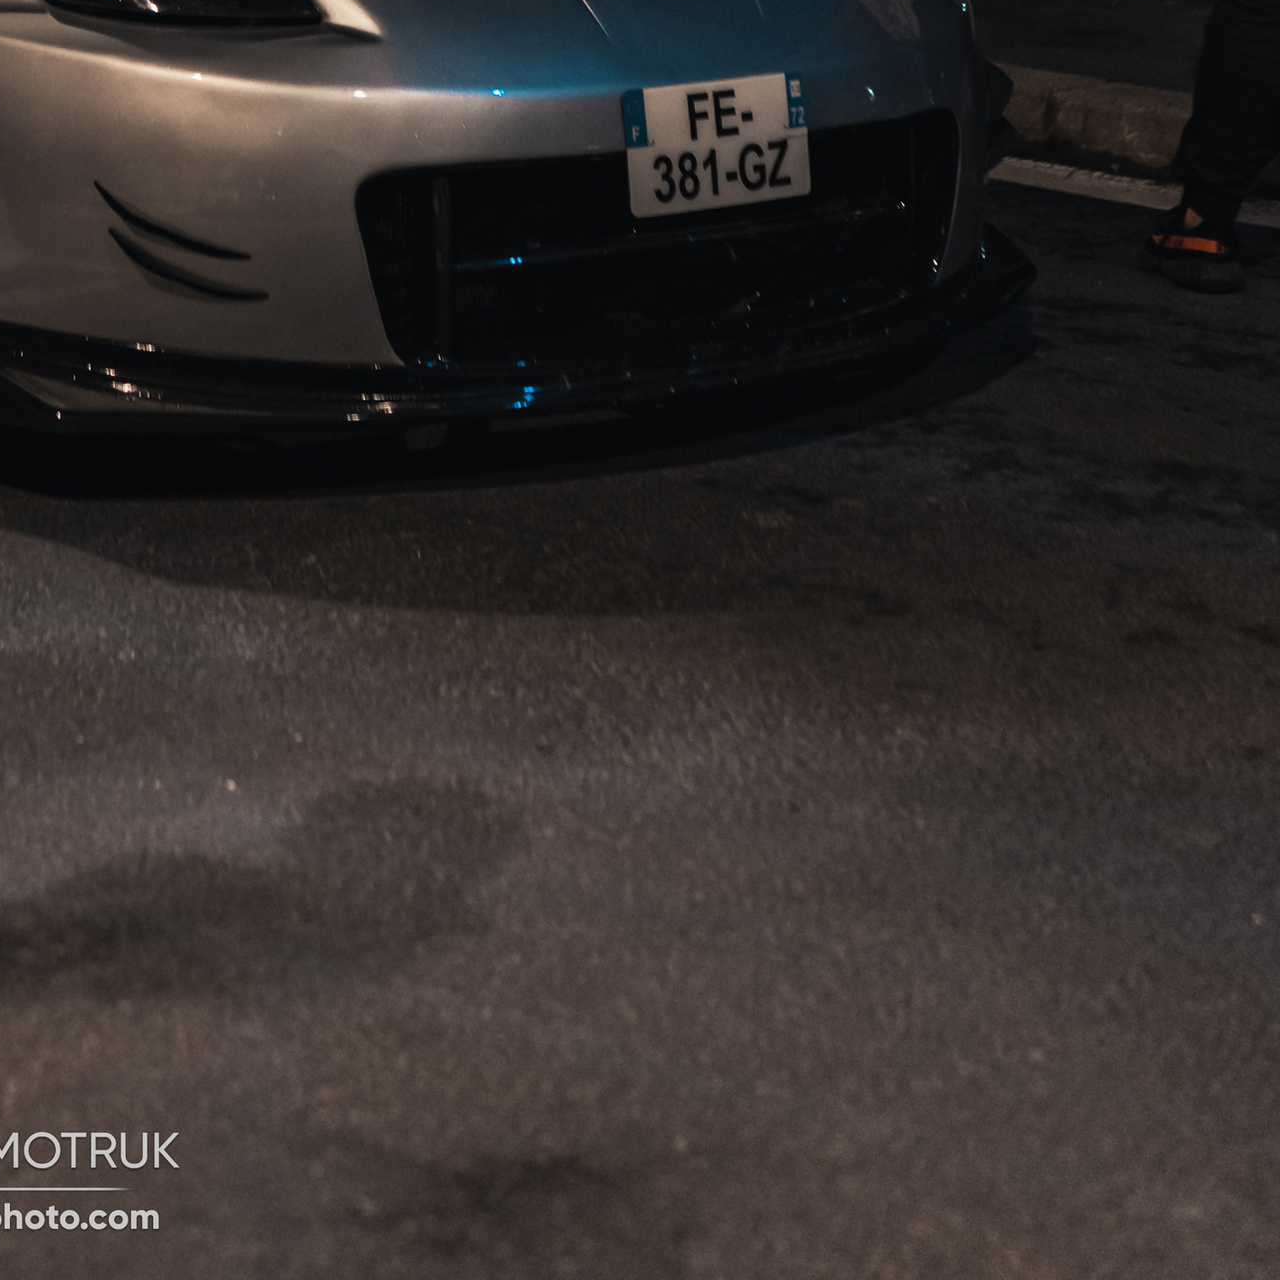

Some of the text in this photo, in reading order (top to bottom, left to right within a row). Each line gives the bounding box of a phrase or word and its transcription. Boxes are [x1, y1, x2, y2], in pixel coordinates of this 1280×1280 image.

[790, 106, 806, 125] 72
[632, 125, 641, 142] F
[652, 139, 792, 204] 381-GZ
